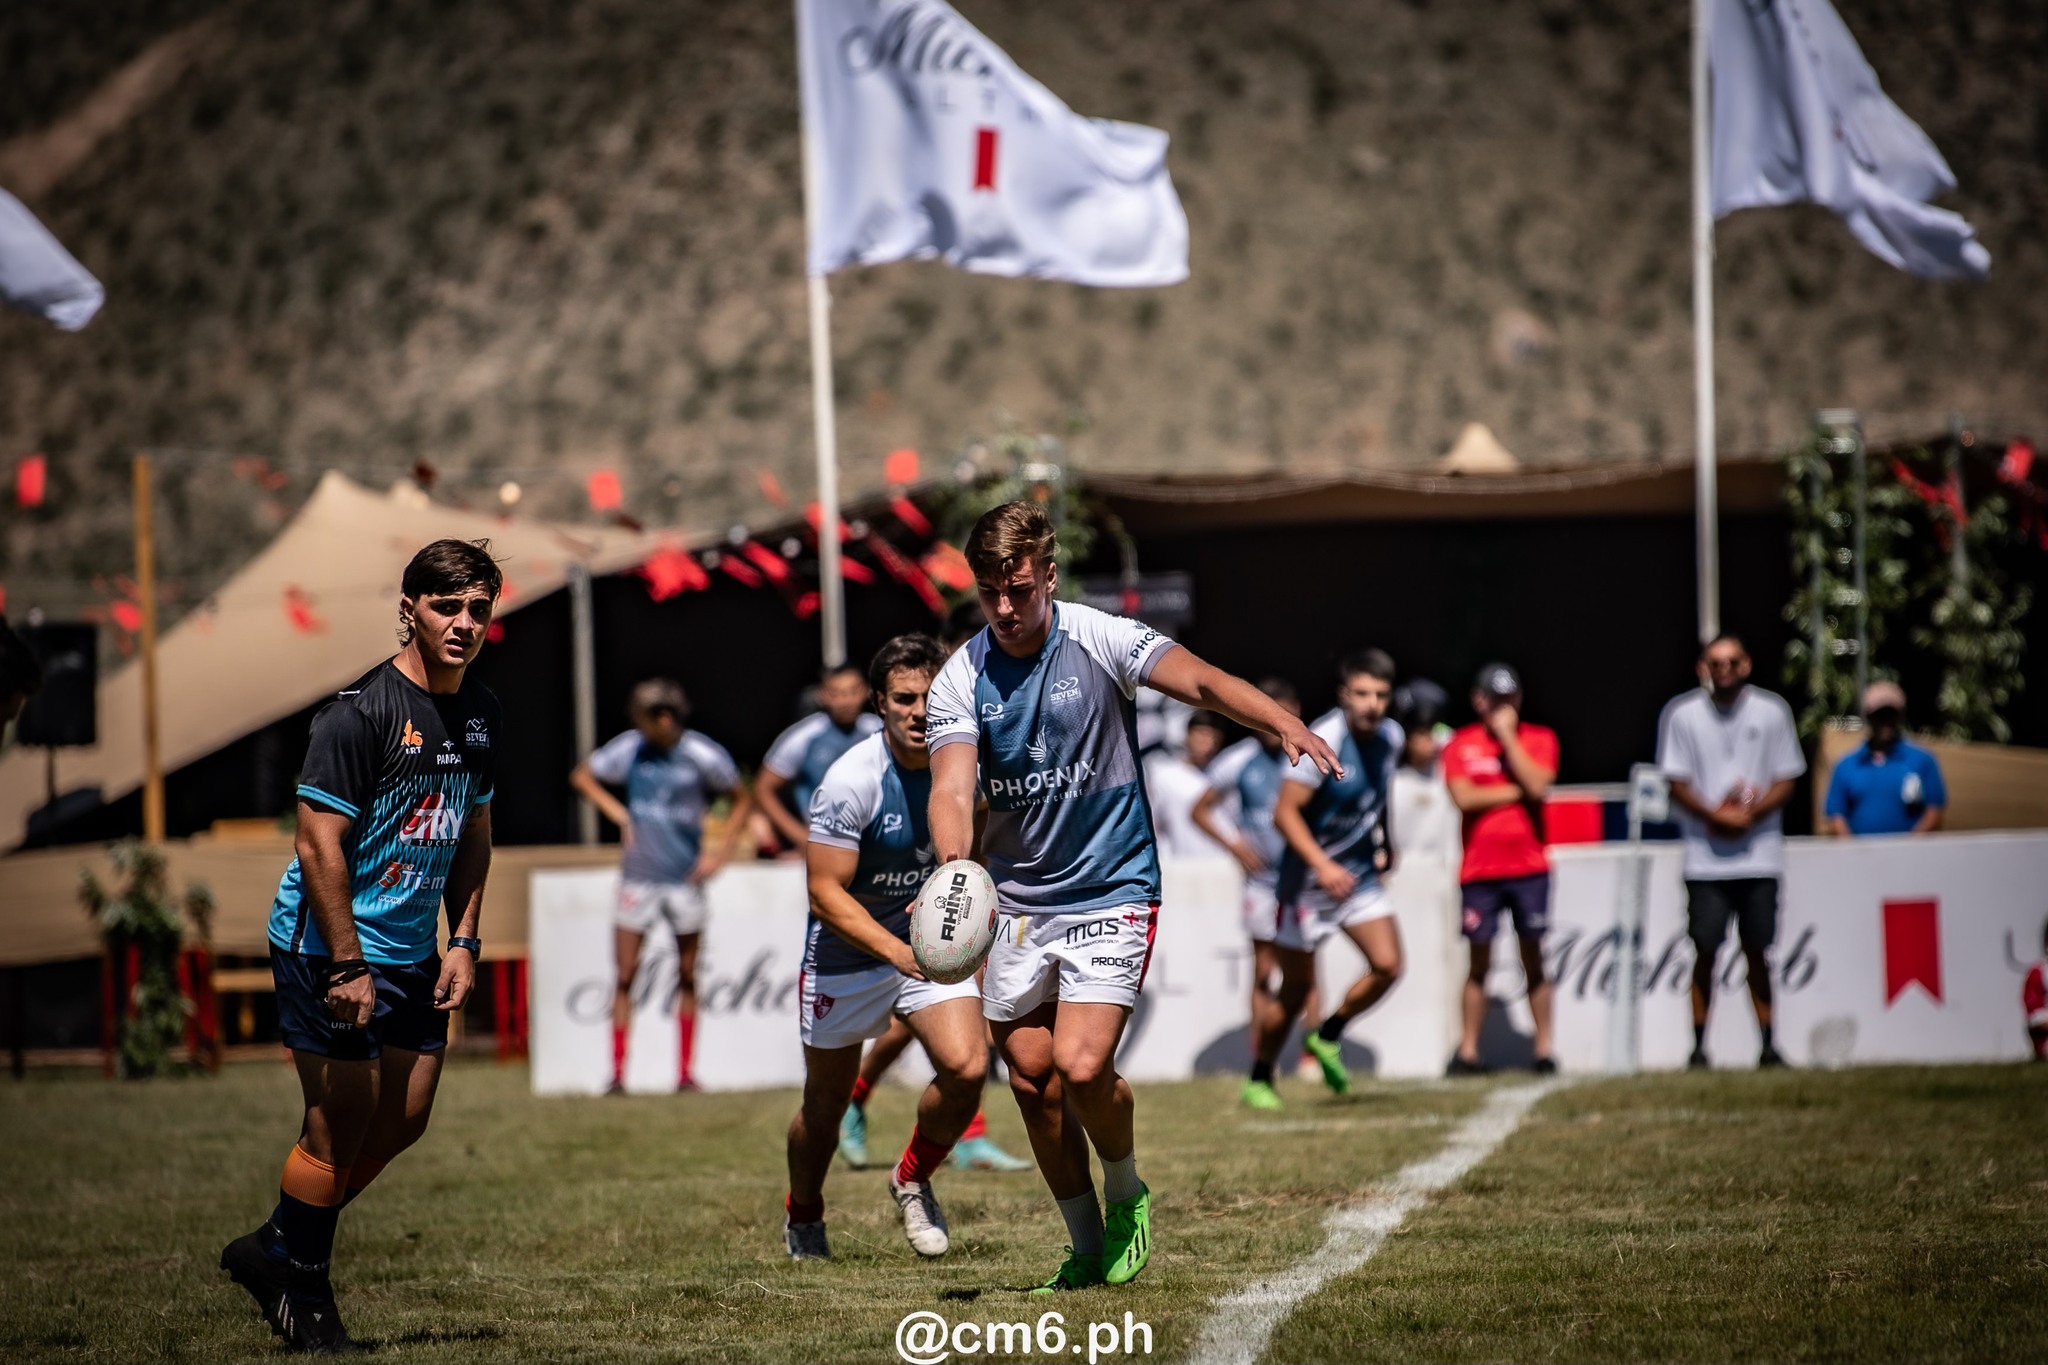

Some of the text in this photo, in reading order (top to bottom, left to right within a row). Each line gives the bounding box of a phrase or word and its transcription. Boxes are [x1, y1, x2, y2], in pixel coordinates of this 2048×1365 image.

[1050, 687, 1079, 702] SEVEN
[990, 757, 1097, 798] PHOENIX
[413, 808, 465, 839] TRY
[940, 872, 968, 941] RHINO
[331, 1021, 354, 1030] URT
